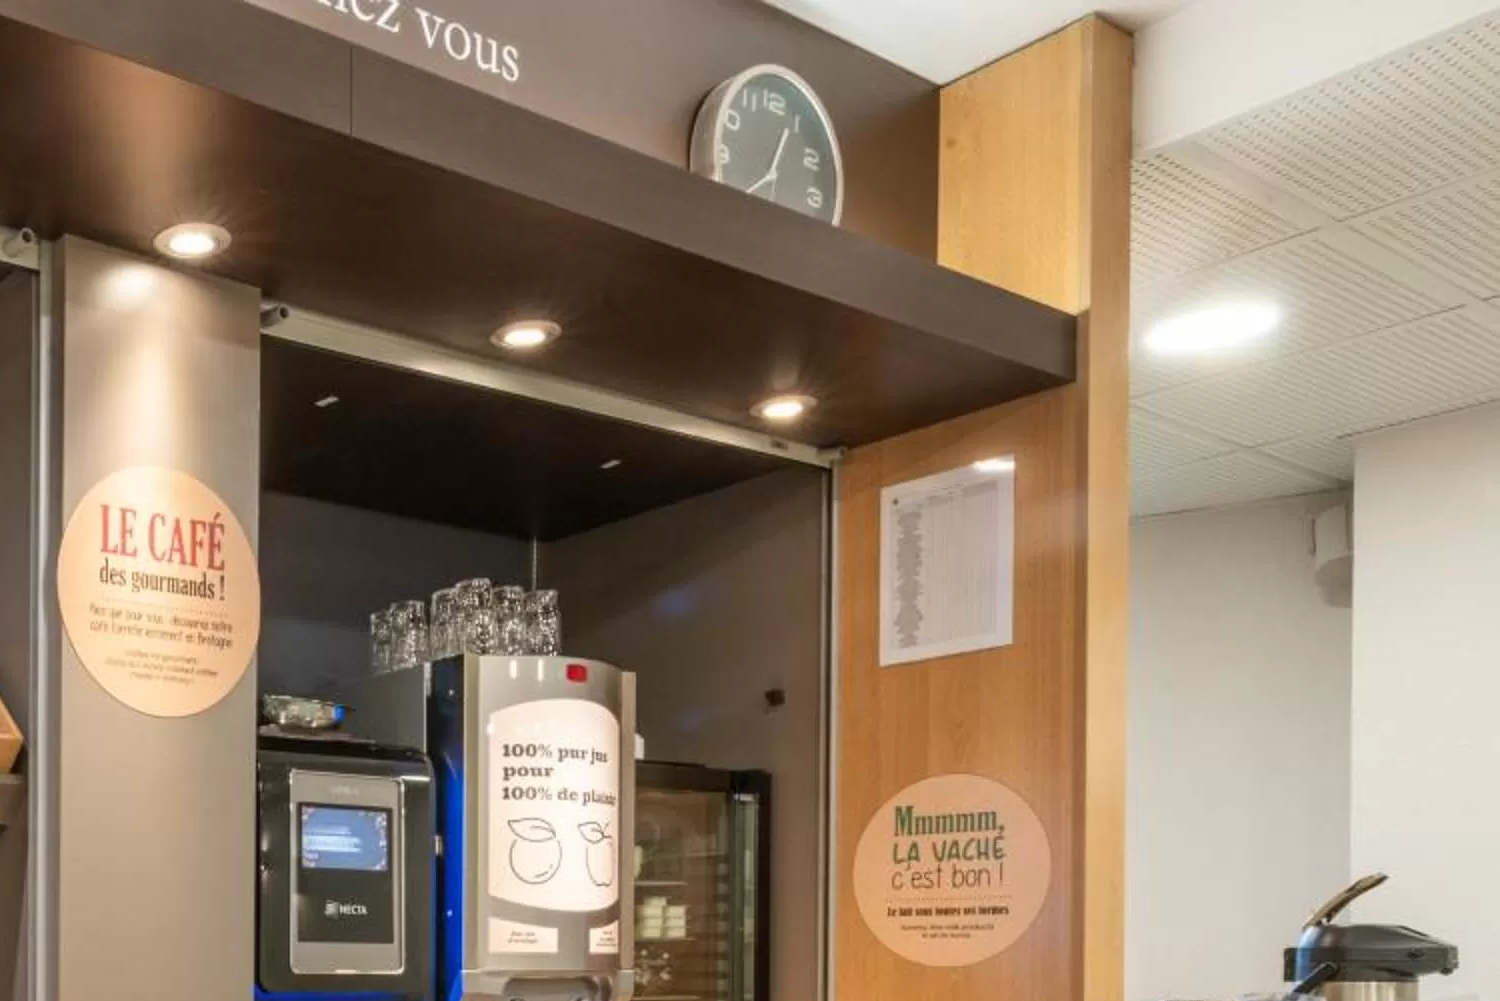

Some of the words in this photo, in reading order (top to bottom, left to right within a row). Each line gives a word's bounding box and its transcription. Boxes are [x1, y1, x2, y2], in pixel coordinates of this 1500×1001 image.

[416, 8, 520, 82] vous
[763, 88, 786, 116] 12
[724, 108, 741, 131] 0
[803, 147, 820, 172] 2
[806, 187, 823, 209] 3
[100, 504, 138, 558] LE
[148, 512, 225, 571] CAFÉ
[99, 557, 127, 585] des
[132, 572, 215, 601] gourmands
[219, 575, 226, 601] !
[502, 744, 552, 758] 100%
[558, 747, 588, 762] pur
[503, 766, 554, 781] pour
[502, 786, 552, 801] 100%
[557, 788, 579, 801] de
[893, 841, 920, 864] LA
[932, 836, 1006, 862] VACHE
[891, 863, 942, 890] c'est
[951, 863, 991, 888] bon
